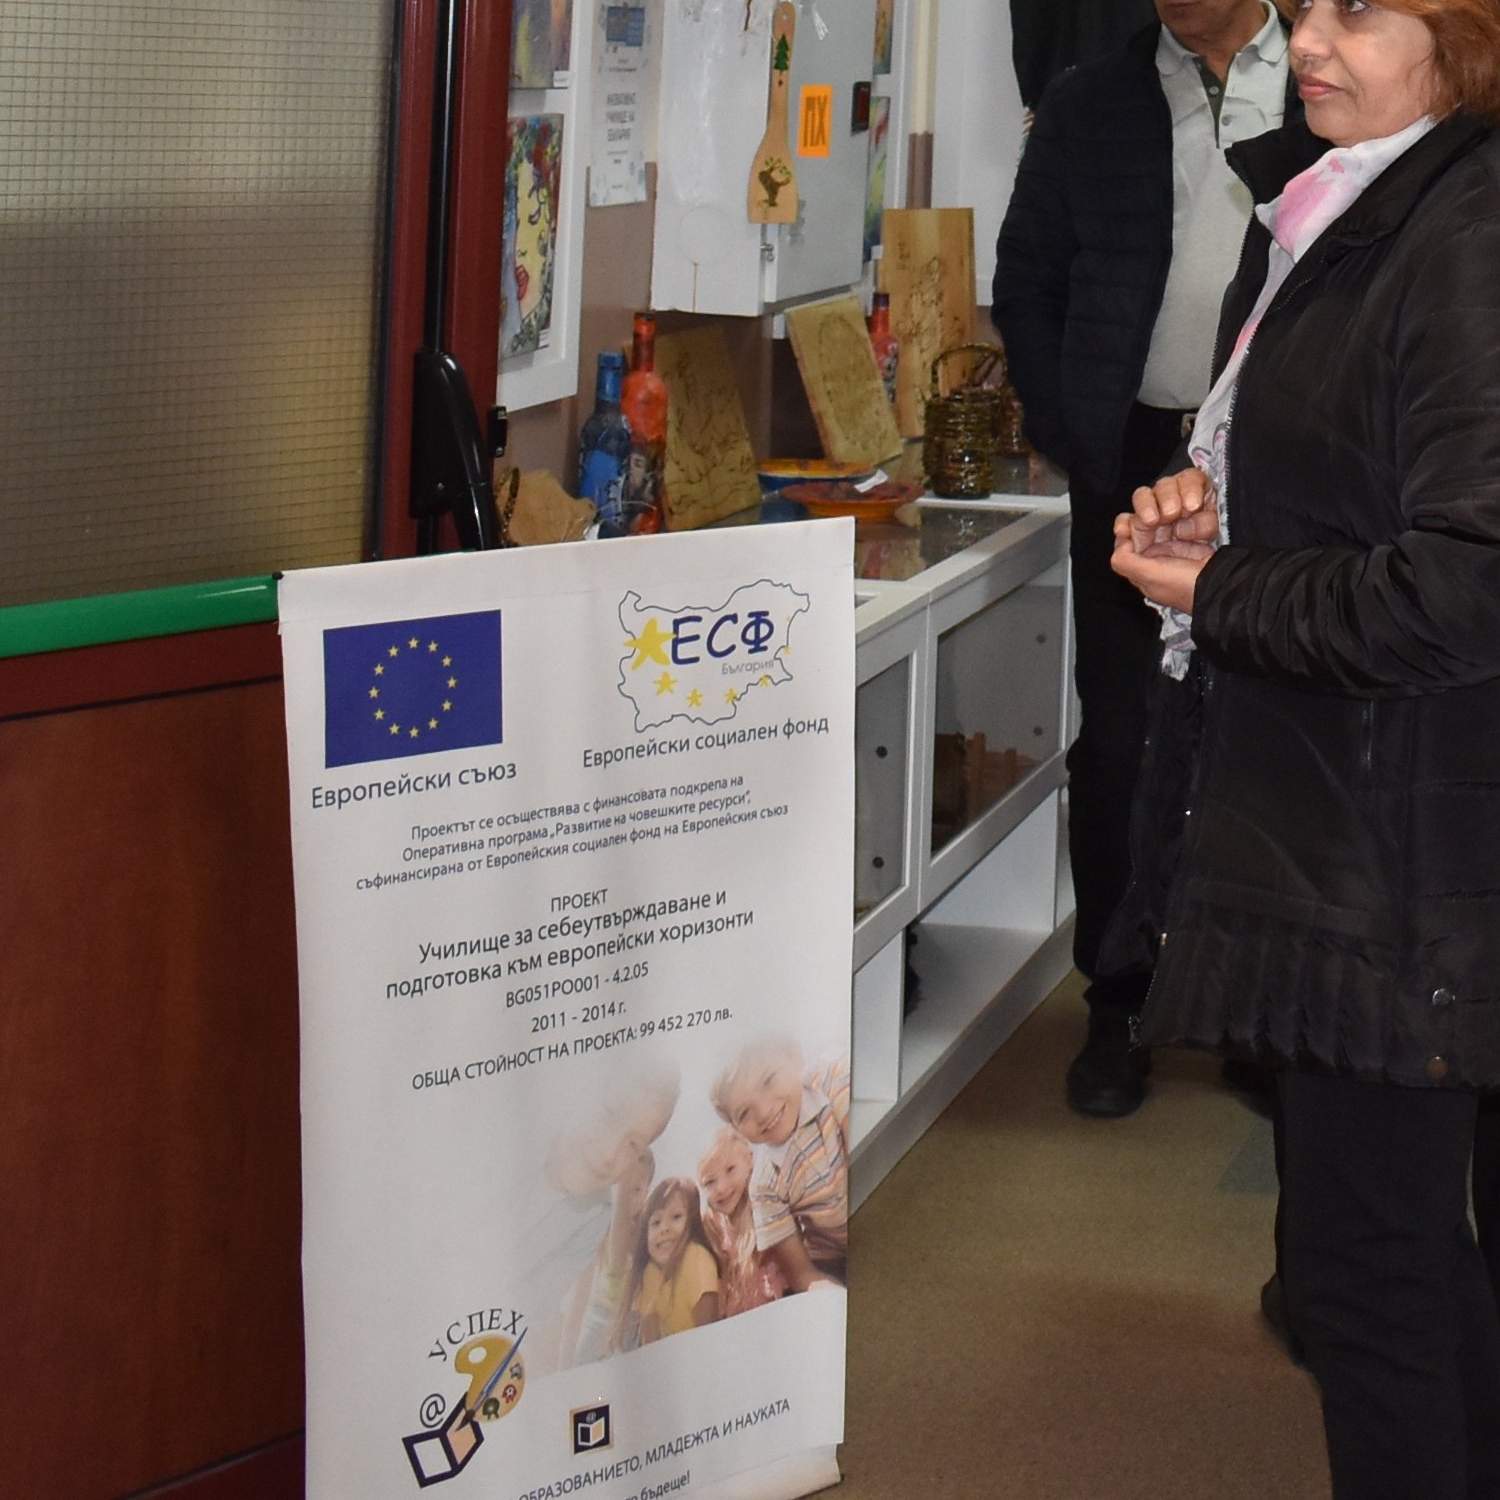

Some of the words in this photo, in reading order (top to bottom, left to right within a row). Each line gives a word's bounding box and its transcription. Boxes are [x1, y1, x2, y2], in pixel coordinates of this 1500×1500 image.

[671, 610, 775, 665] ЕСФ
[721, 659, 775, 675] България
[583, 738, 690, 769] Европейски
[695, 724, 778, 752] социален
[783, 717, 829, 740] фонд
[312, 772, 451, 809] Европейски
[458, 762, 517, 785] съюз
[411, 820, 475, 841] Проектът
[478, 817, 494, 830] се
[496, 802, 580, 826] осъществява
[583, 802, 590, 813] с
[593, 787, 667, 813] финансовата
[670, 781, 728, 797] подкрепа
[730, 775, 744, 788] на
[356, 861, 464, 891] съфинансирана
[467, 858, 482, 871] от
[486, 842, 569, 869] Европейския
[572, 832, 627, 854] социален
[629, 825, 661, 844] фонд
[664, 821, 679, 836] на
[682, 810, 758, 834] Европейския
[760, 804, 789, 820] съюз
[402, 838, 484, 862] Оперативна
[488, 828, 548, 850] програма
[613, 813, 627, 826] на
[629, 802, 696, 822] човешките
[419, 933, 510, 964] Училище
[514, 928, 533, 946] за
[537, 893, 711, 940] себеутвърждаване
[716, 890, 727, 906] и
[551, 888, 608, 913] ПРОЕКТ
[386, 963, 502, 1000] подготовка
[507, 953, 543, 976] към
[547, 929, 654, 967] европейски
[659, 910, 754, 944] хоризонти
[506, 974, 600, 1008] BG051PO001
[612, 961, 649, 984] 4.2.05
[531, 1012, 566, 1033] 2011
[581, 1001, 616, 1024] 2014
[618, 1001, 627, 1015] г.
[412, 1067, 461, 1090] ОБЩА
[464, 1046, 545, 1080] СТОЙНОСТ
[548, 1042, 570, 1060] НА
[573, 1025, 637, 1055] ПРОЕКТА:
[639, 1022, 655, 1038] 99
[658, 1015, 683, 1032] 452
[687, 1008, 711, 1027] 270
[713, 1007, 733, 1022] лв.
[427, 1308, 525, 1362] УСПЕХ
[645, 1425, 719, 1466] МЛАДЕЖТА
[722, 1419, 732, 1436] И
[735, 1398, 790, 1431] НАУКАТА
[640, 1469, 690, 1500] бъдеще!
